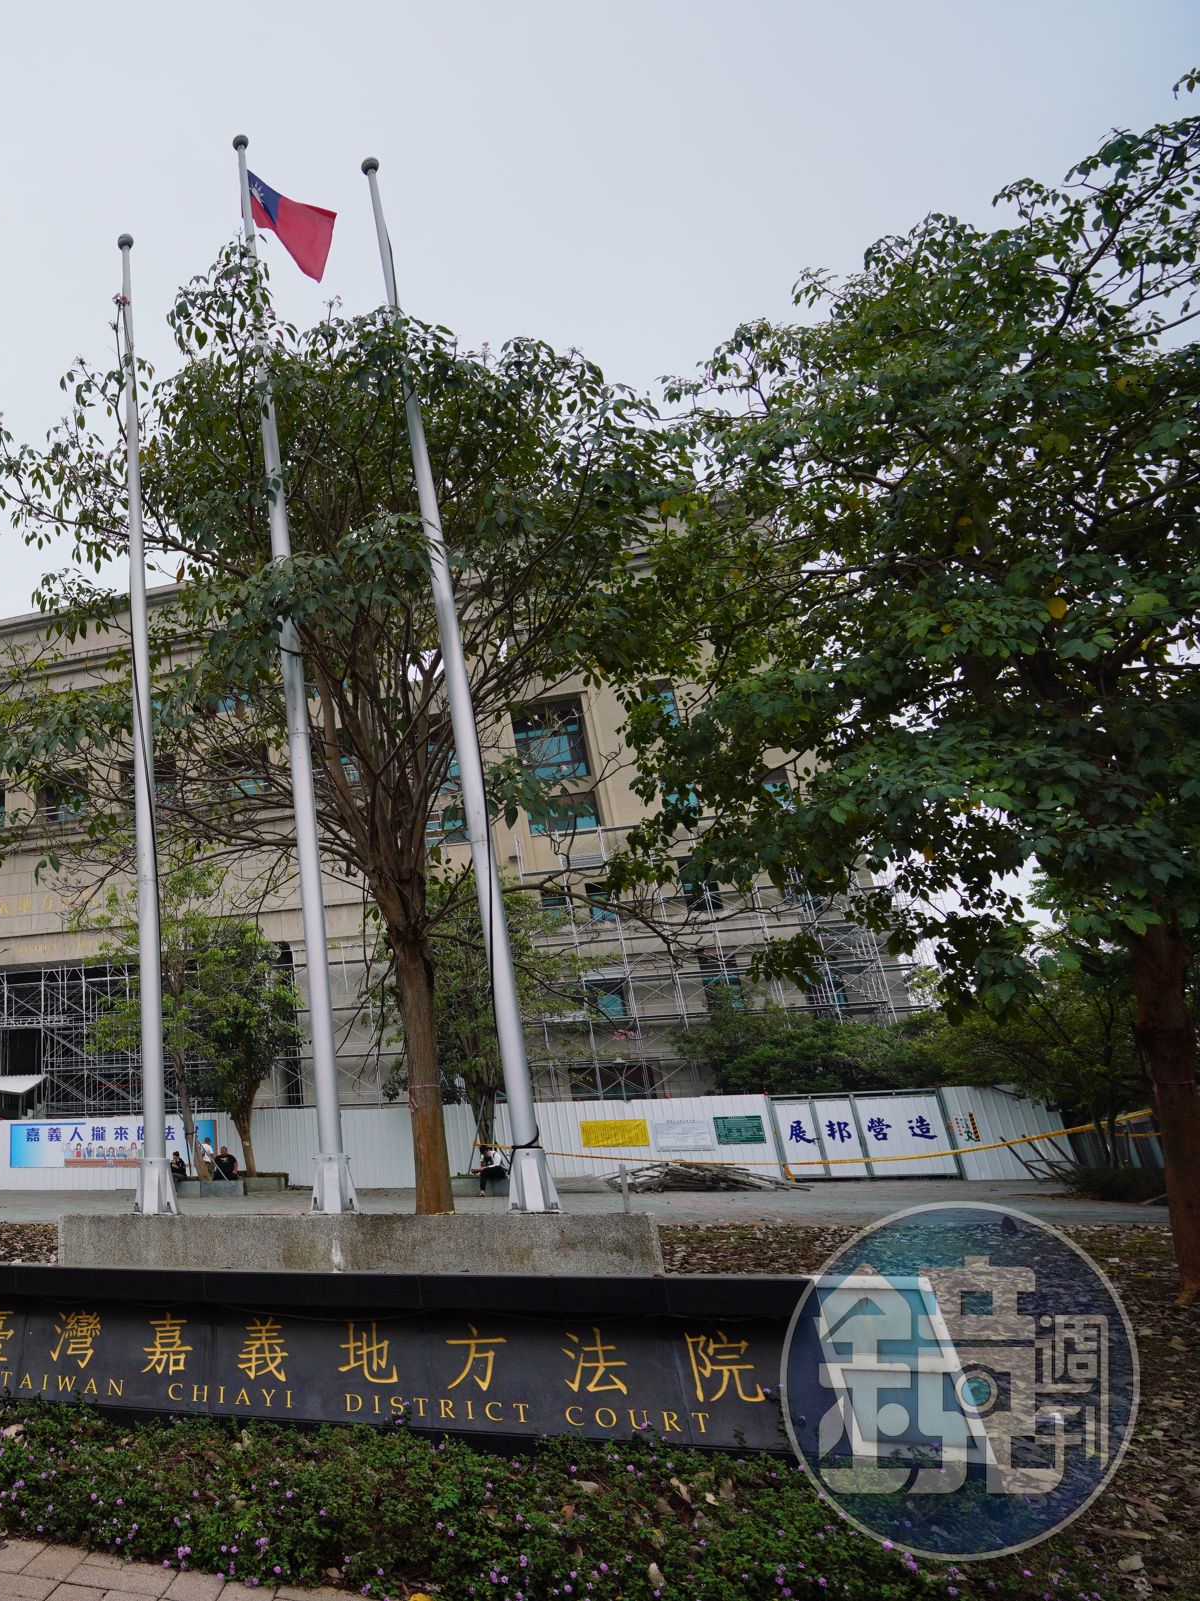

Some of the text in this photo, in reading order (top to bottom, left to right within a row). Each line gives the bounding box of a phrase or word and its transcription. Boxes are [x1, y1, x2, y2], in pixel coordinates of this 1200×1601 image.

[789, 1115, 938, 1144] 展邦營造
[1, 1370, 711, 1433] TAIWAN CHIAYI DISTRICT COURT
